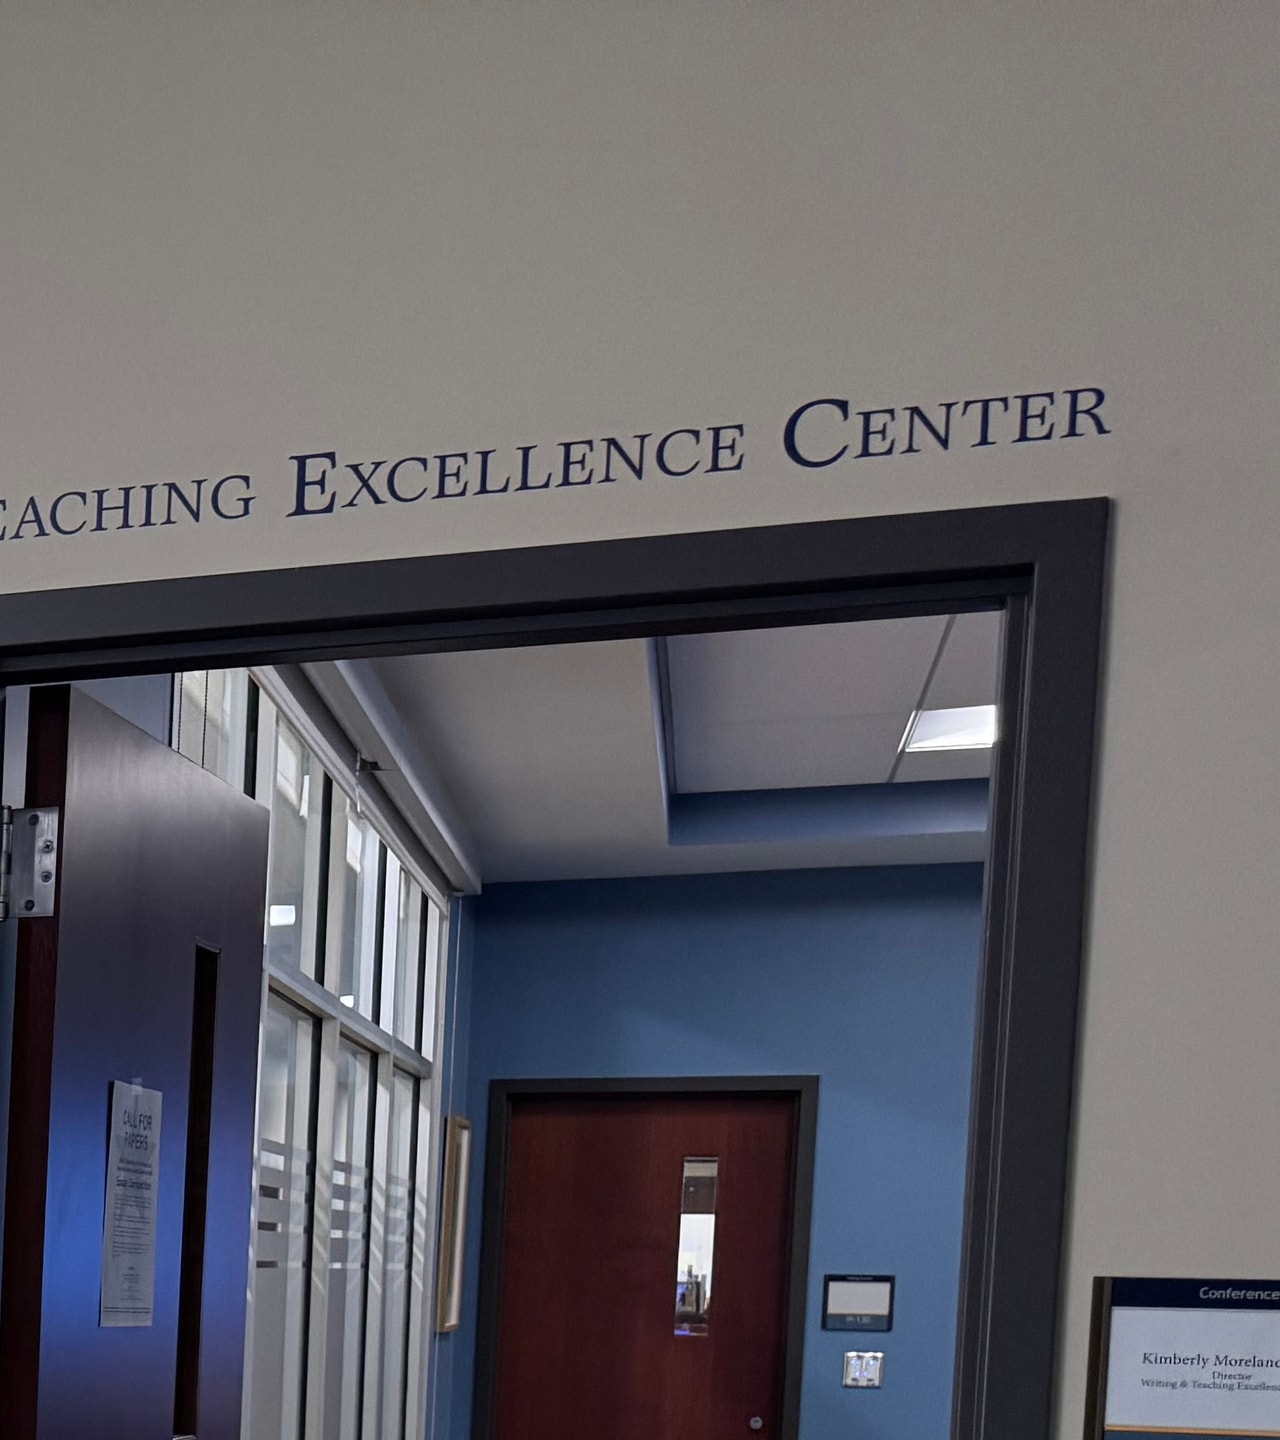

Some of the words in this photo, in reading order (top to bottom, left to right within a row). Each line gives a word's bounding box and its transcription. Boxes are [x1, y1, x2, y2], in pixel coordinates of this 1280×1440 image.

[286, 423, 745, 518] EXCELLENCE
[783, 387, 1111, 469] CENTER
[139, 1113, 152, 1130] FOR
[1199, 1286, 1280, 1301] Conference
[1142, 1352, 1210, 1369] Kimberly
[1212, 1371, 1252, 1380] Director
[1141, 1379, 1177, 1390] Writing
[1179, 1380, 1188, 1388] &
[1192, 1380, 1234, 1391] Teaching
